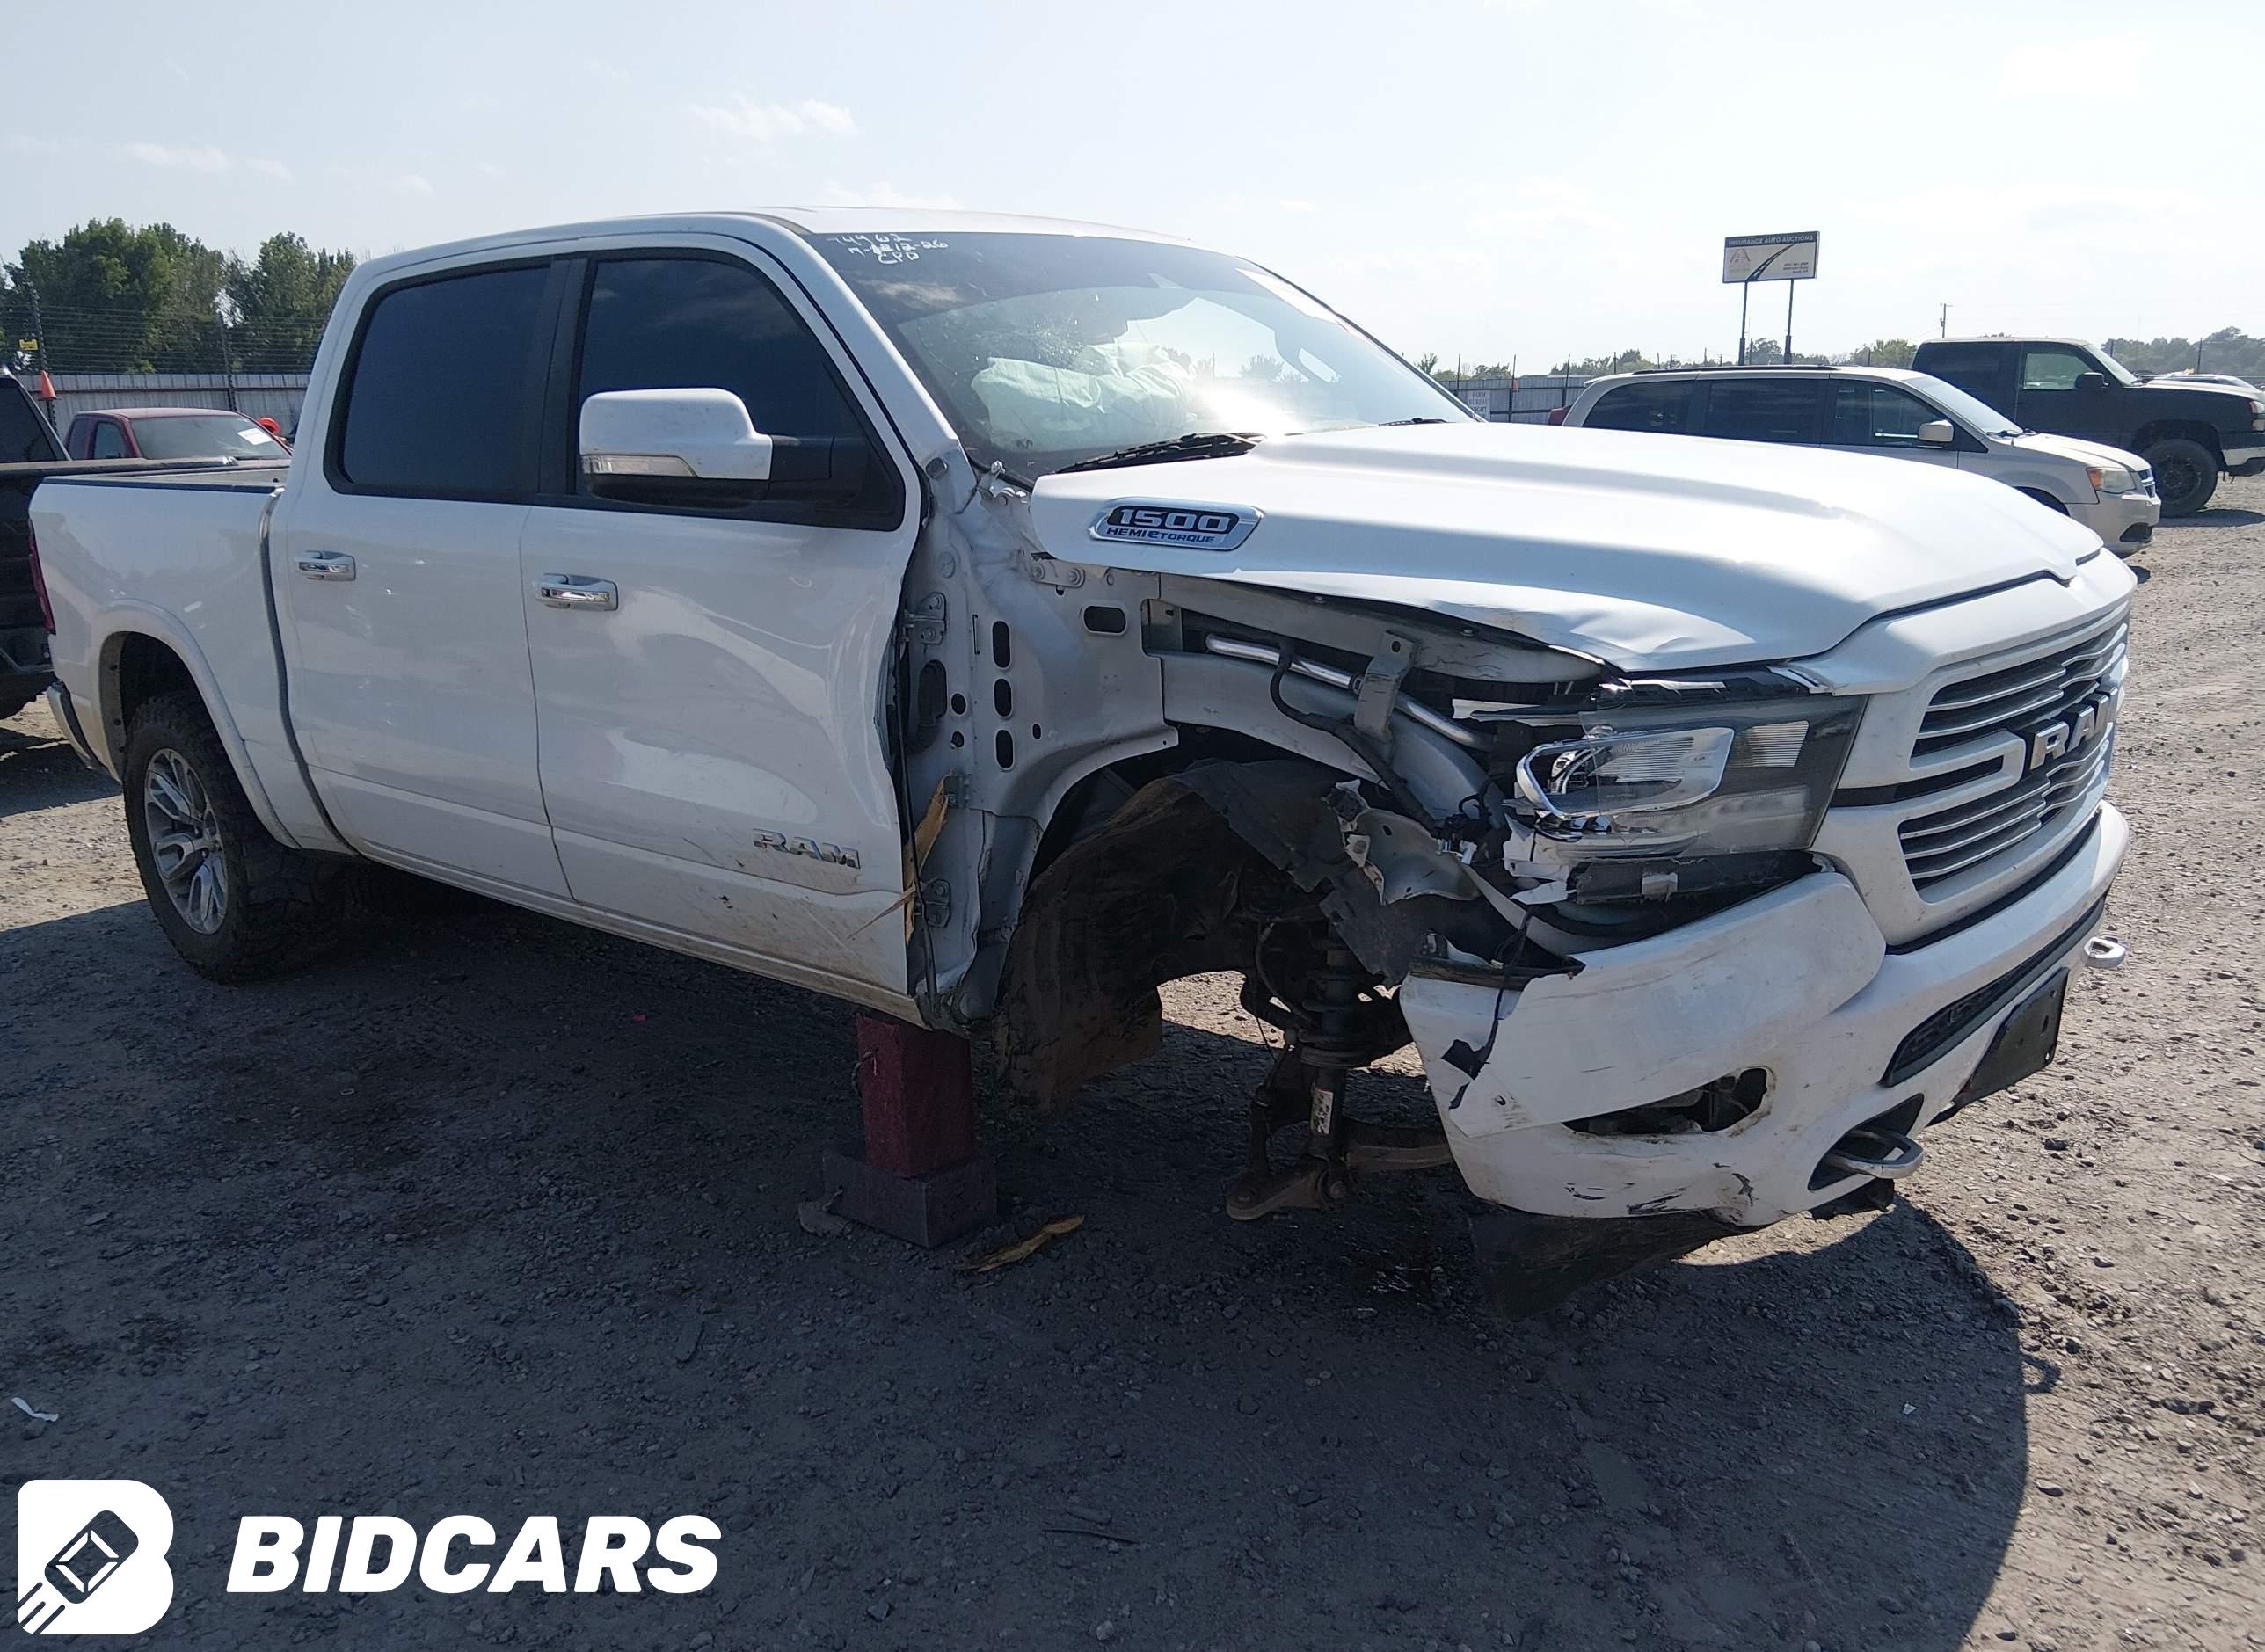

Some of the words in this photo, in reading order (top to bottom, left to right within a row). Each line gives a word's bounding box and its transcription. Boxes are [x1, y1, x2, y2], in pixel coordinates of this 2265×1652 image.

[1781, 234, 1814, 244] AUCTIONS
[1119, 508, 1231, 532] 1500
[1106, 527, 1146, 538] HEMI
[2029, 686, 2118, 771] RAM
[753, 827, 861, 870] RAM
